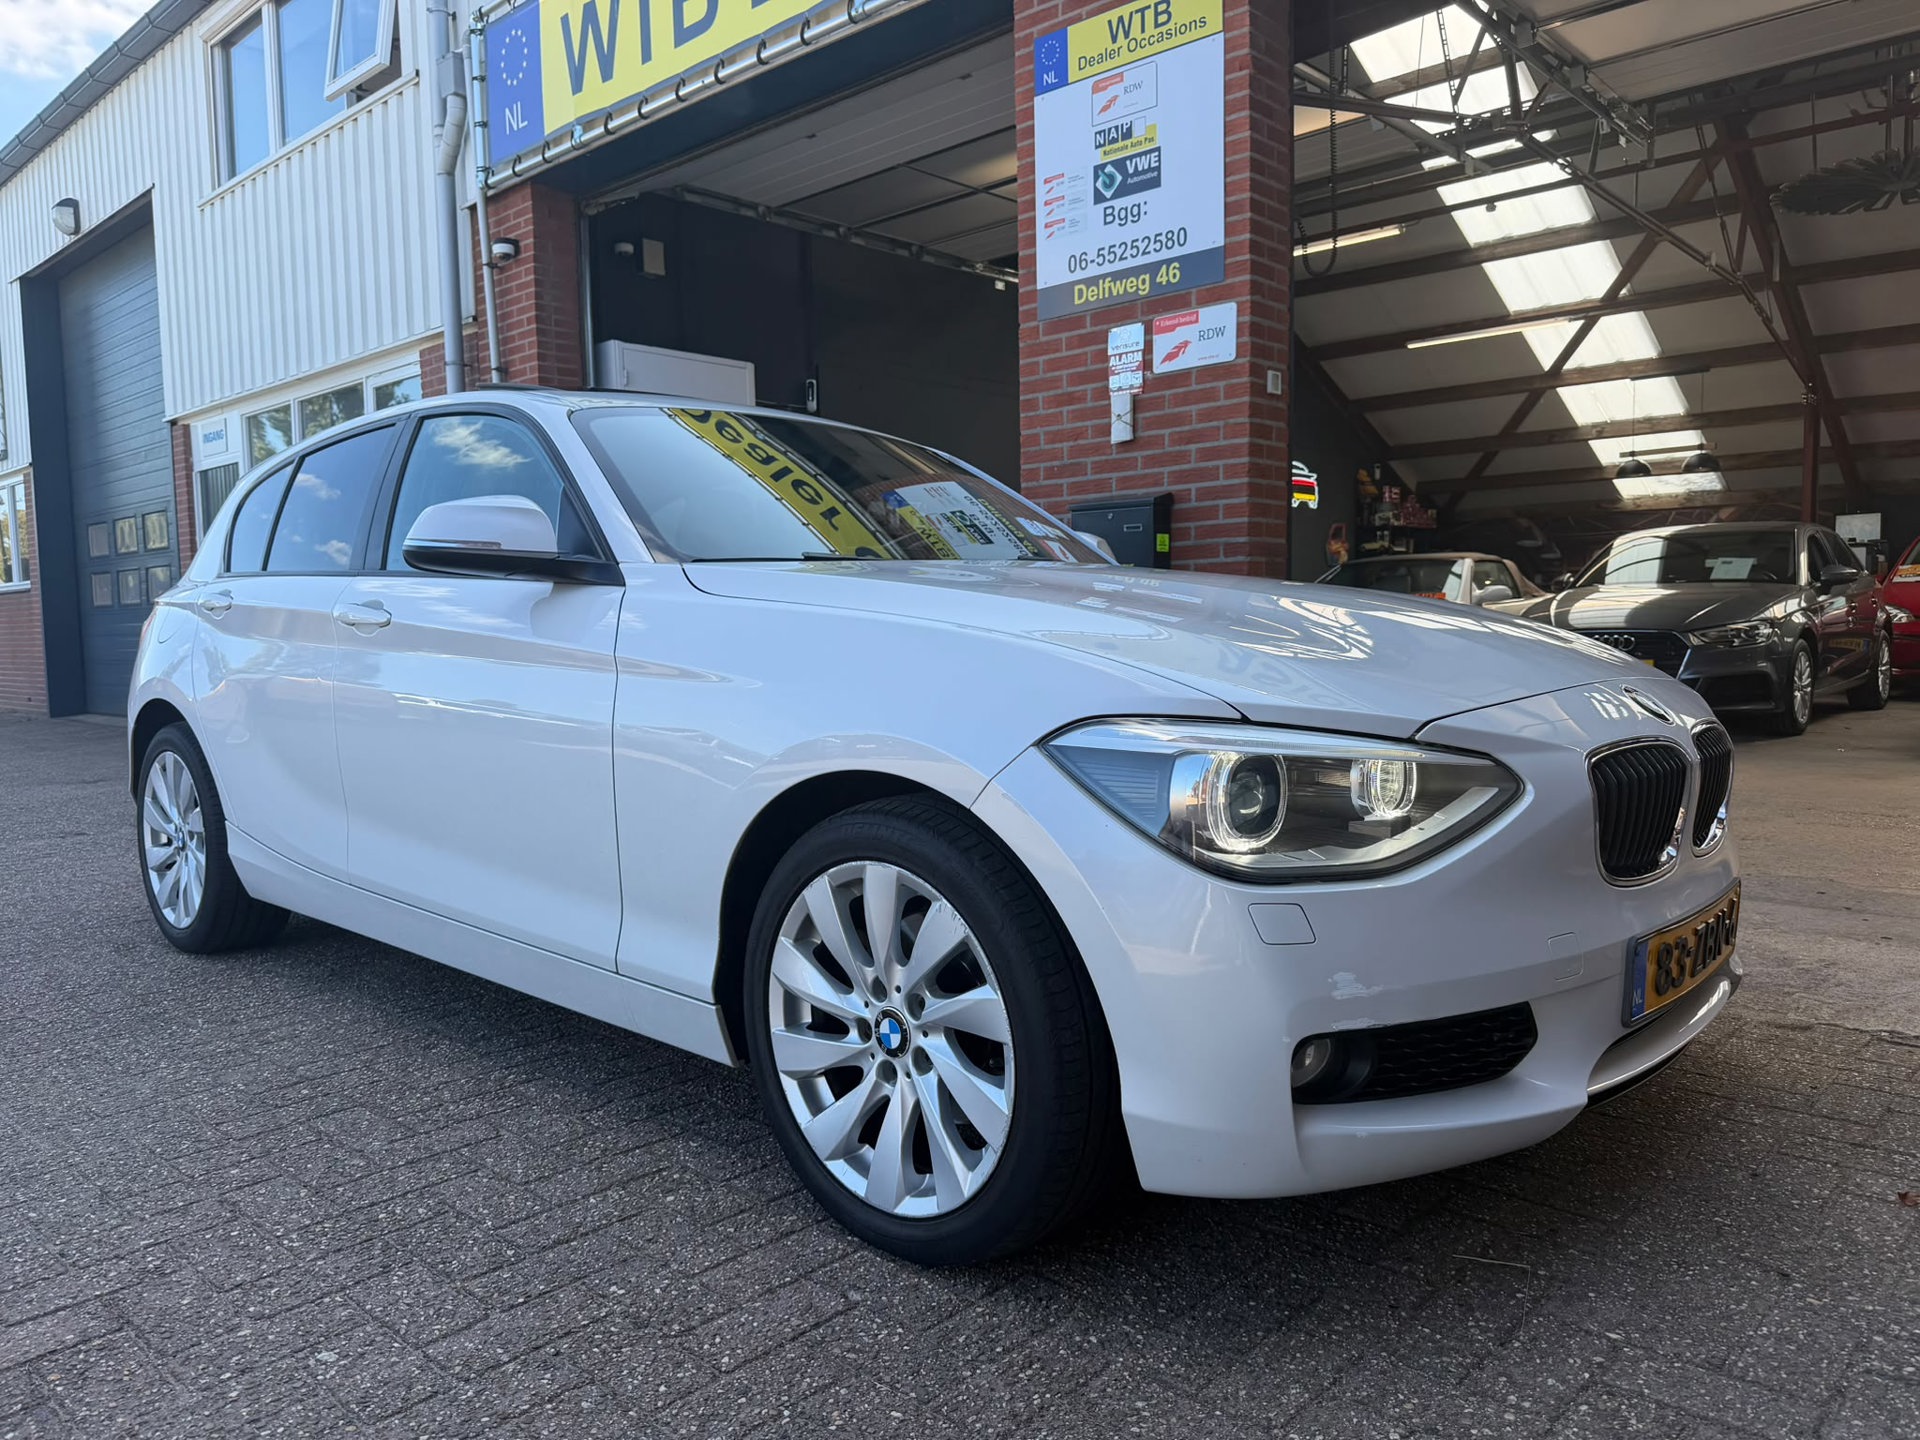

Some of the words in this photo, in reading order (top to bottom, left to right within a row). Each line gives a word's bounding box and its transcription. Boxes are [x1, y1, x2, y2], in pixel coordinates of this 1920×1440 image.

[1107, 0, 1173, 45] WTB
[1078, 46, 1123, 71] Dealer
[1127, 16, 1207, 53] Occasions
[1043, 71, 1058, 86] NL
[1123, 80, 1143, 95] RDW
[505, 101, 528, 135] NL
[1125, 152, 1159, 174] VWE
[1103, 201, 1148, 227] Bgg:
[1068, 227, 1187, 273] 06-55252580
[1074, 274, 1150, 305] Delfweg
[1156, 262, 1181, 285] 46
[1198, 326, 1226, 341] RDW
[1110, 351, 1142, 367] ALARM
